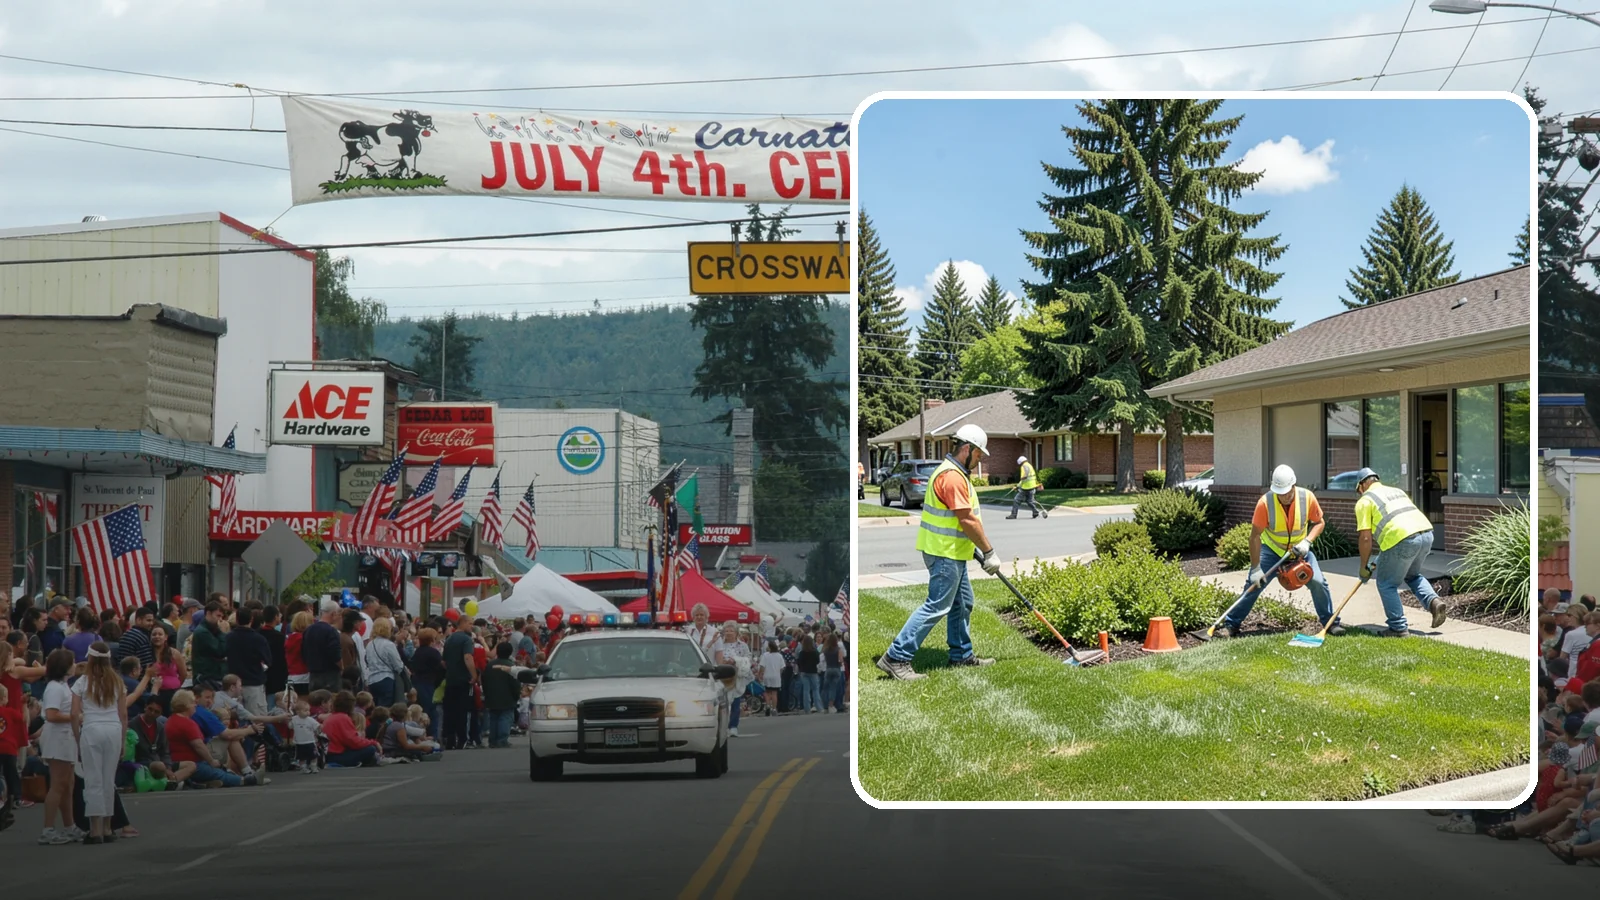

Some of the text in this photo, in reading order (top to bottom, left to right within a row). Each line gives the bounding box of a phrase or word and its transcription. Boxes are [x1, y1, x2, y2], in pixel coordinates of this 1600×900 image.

[481, 141, 605, 192] JULY
[632, 150, 747, 198] 4th.
[697, 254, 850, 280] CROSSWA
[282, 380, 373, 419] ACE
[406, 409, 452, 422] CEDAR
[283, 421, 371, 436] Hardware
[416, 428, 477, 447] Coca-Cola
[96, 485, 124, 495] Vincent
[126, 486, 136, 495] de
[137, 486, 155, 495] Paul
[212, 515, 331, 535] HARDARE
[688, 526, 741, 535] CRNATION
[699, 535, 730, 543] GLASS
